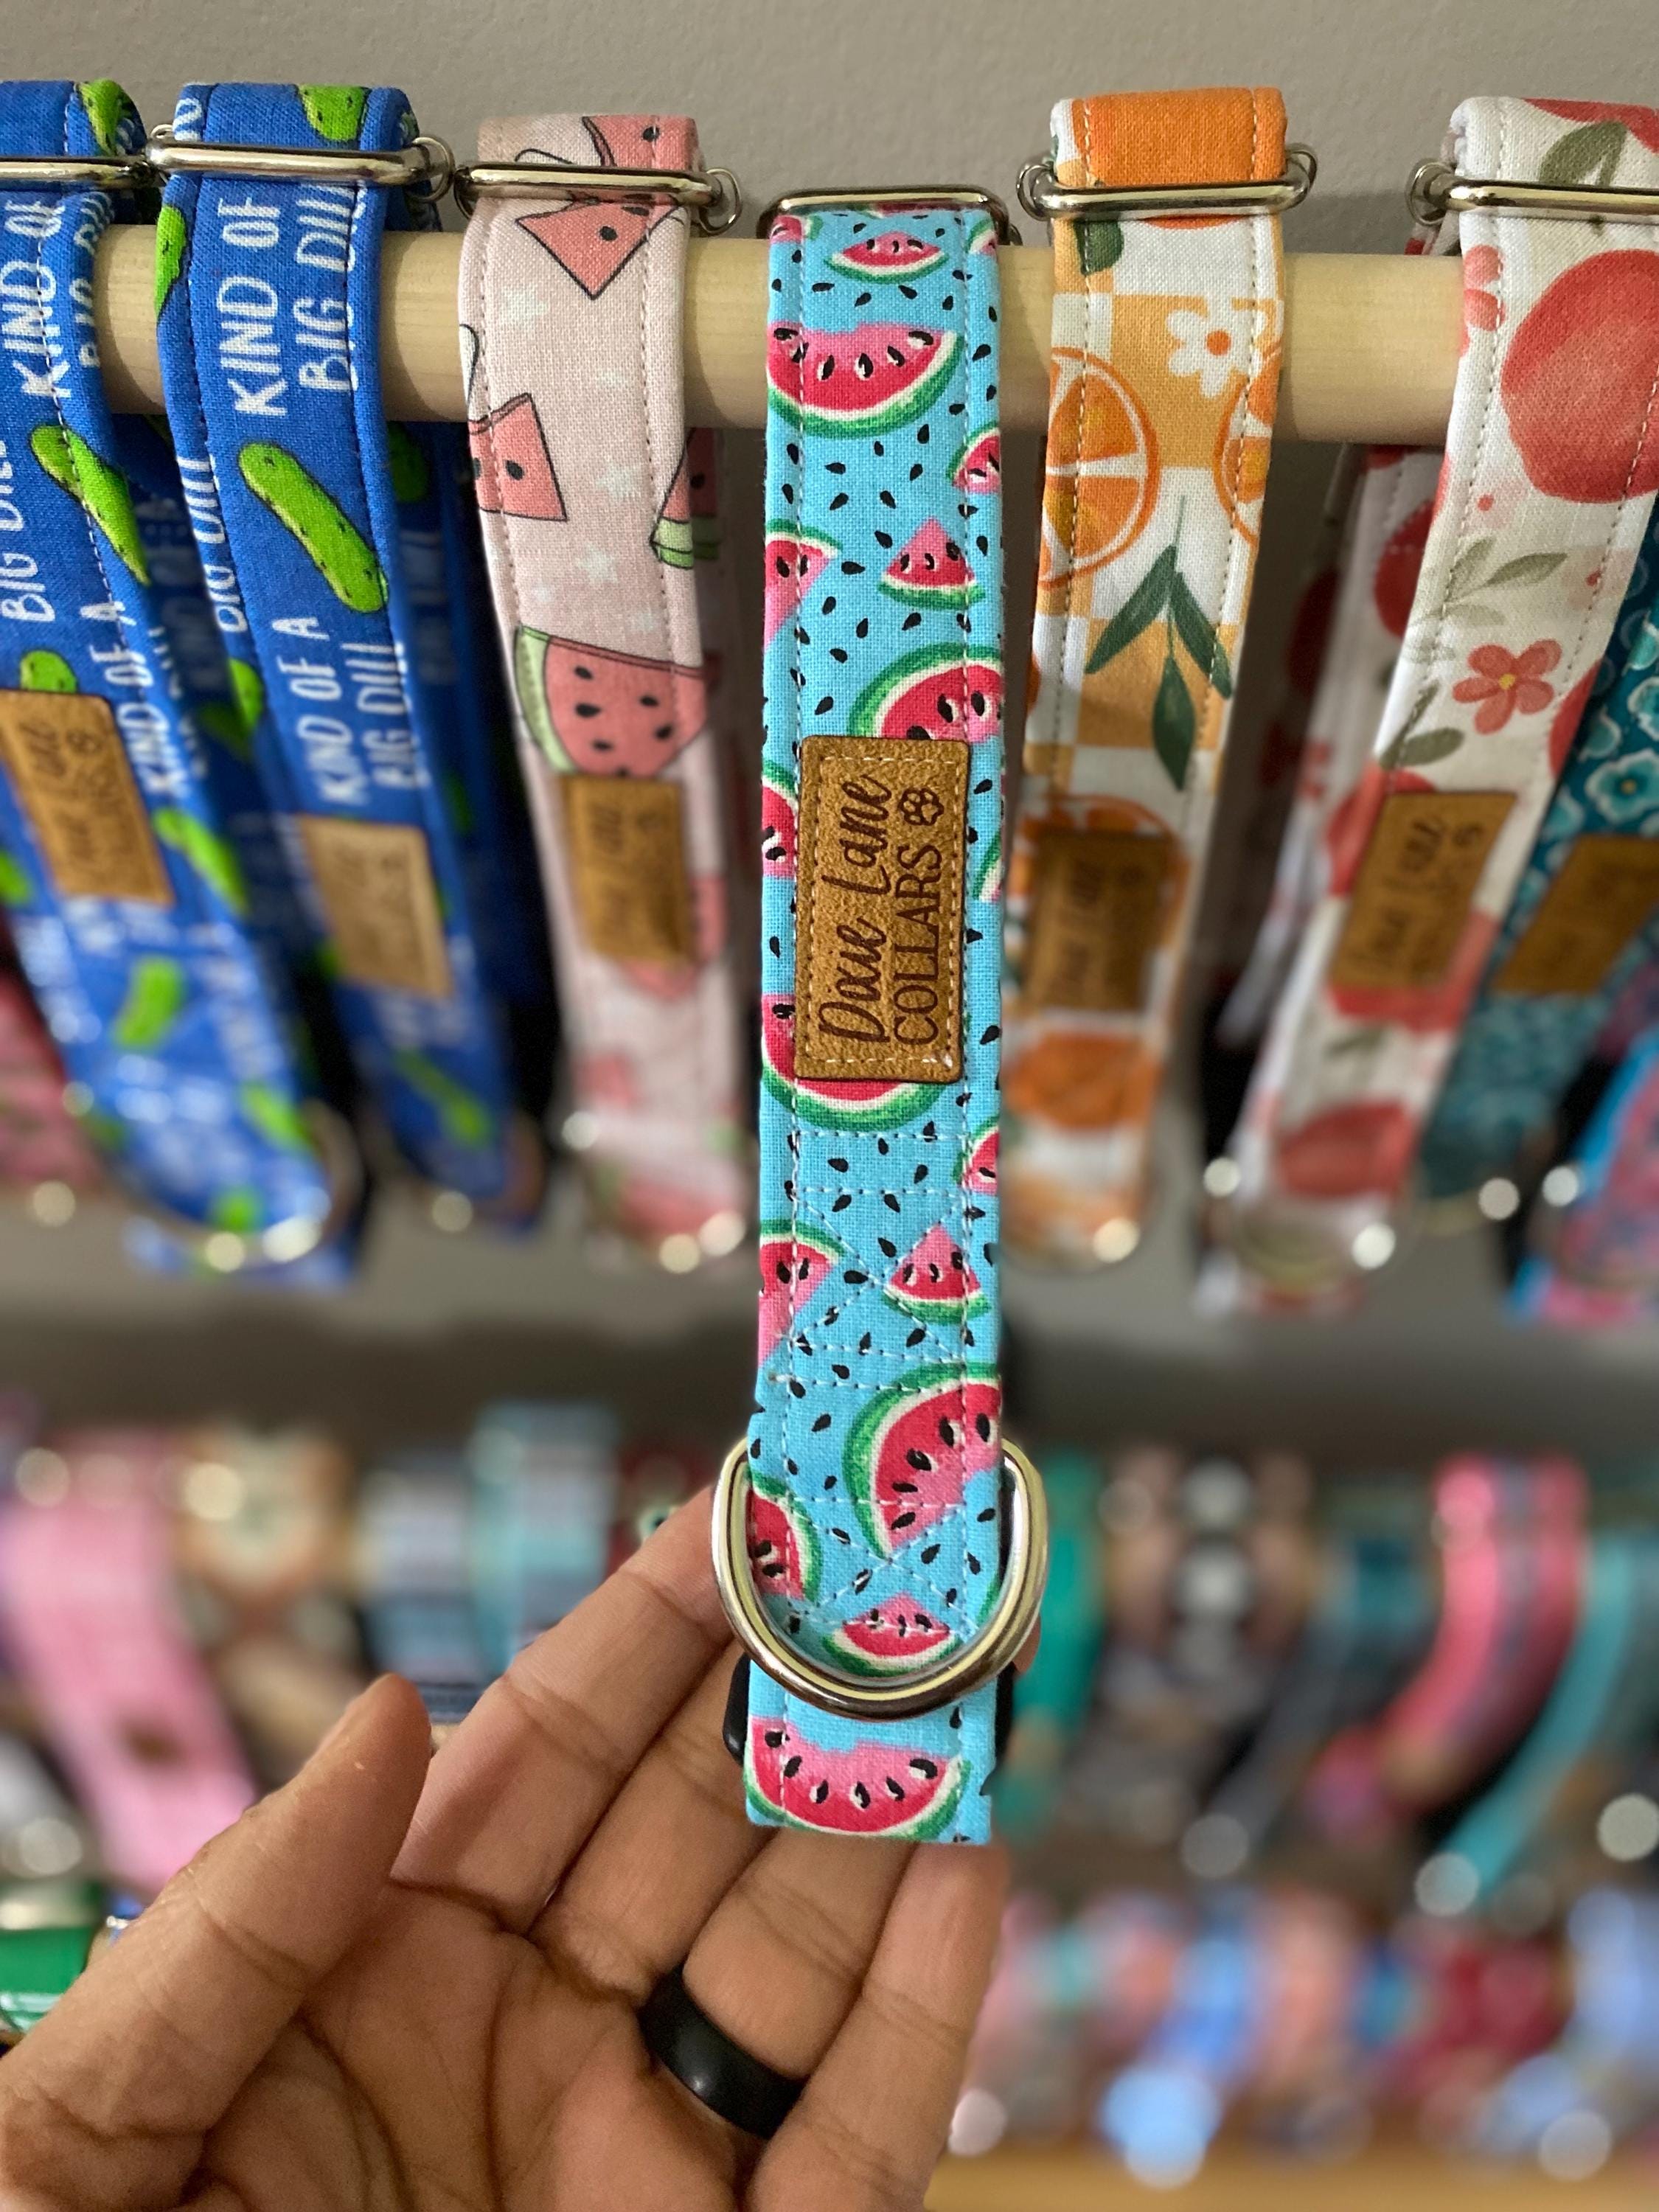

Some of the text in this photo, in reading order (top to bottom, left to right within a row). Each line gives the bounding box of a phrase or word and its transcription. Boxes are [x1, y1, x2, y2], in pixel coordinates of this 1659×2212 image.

[0, 260, 72, 399] KIND
[217, 196, 289, 417] KIND OF
[293, 295, 358, 392] BIG
[0, 552, 55, 624] BIG
[80, 600, 138, 627] A
[271, 616, 330, 641] A
[88, 643, 155, 688] OF
[277, 655, 343, 702] OF
[296, 715, 369, 805] KIND
[362, 726, 432, 790] BIG
[818, 773, 893, 1043] Dixie Lane
[892, 844, 943, 1046] COLLARS
